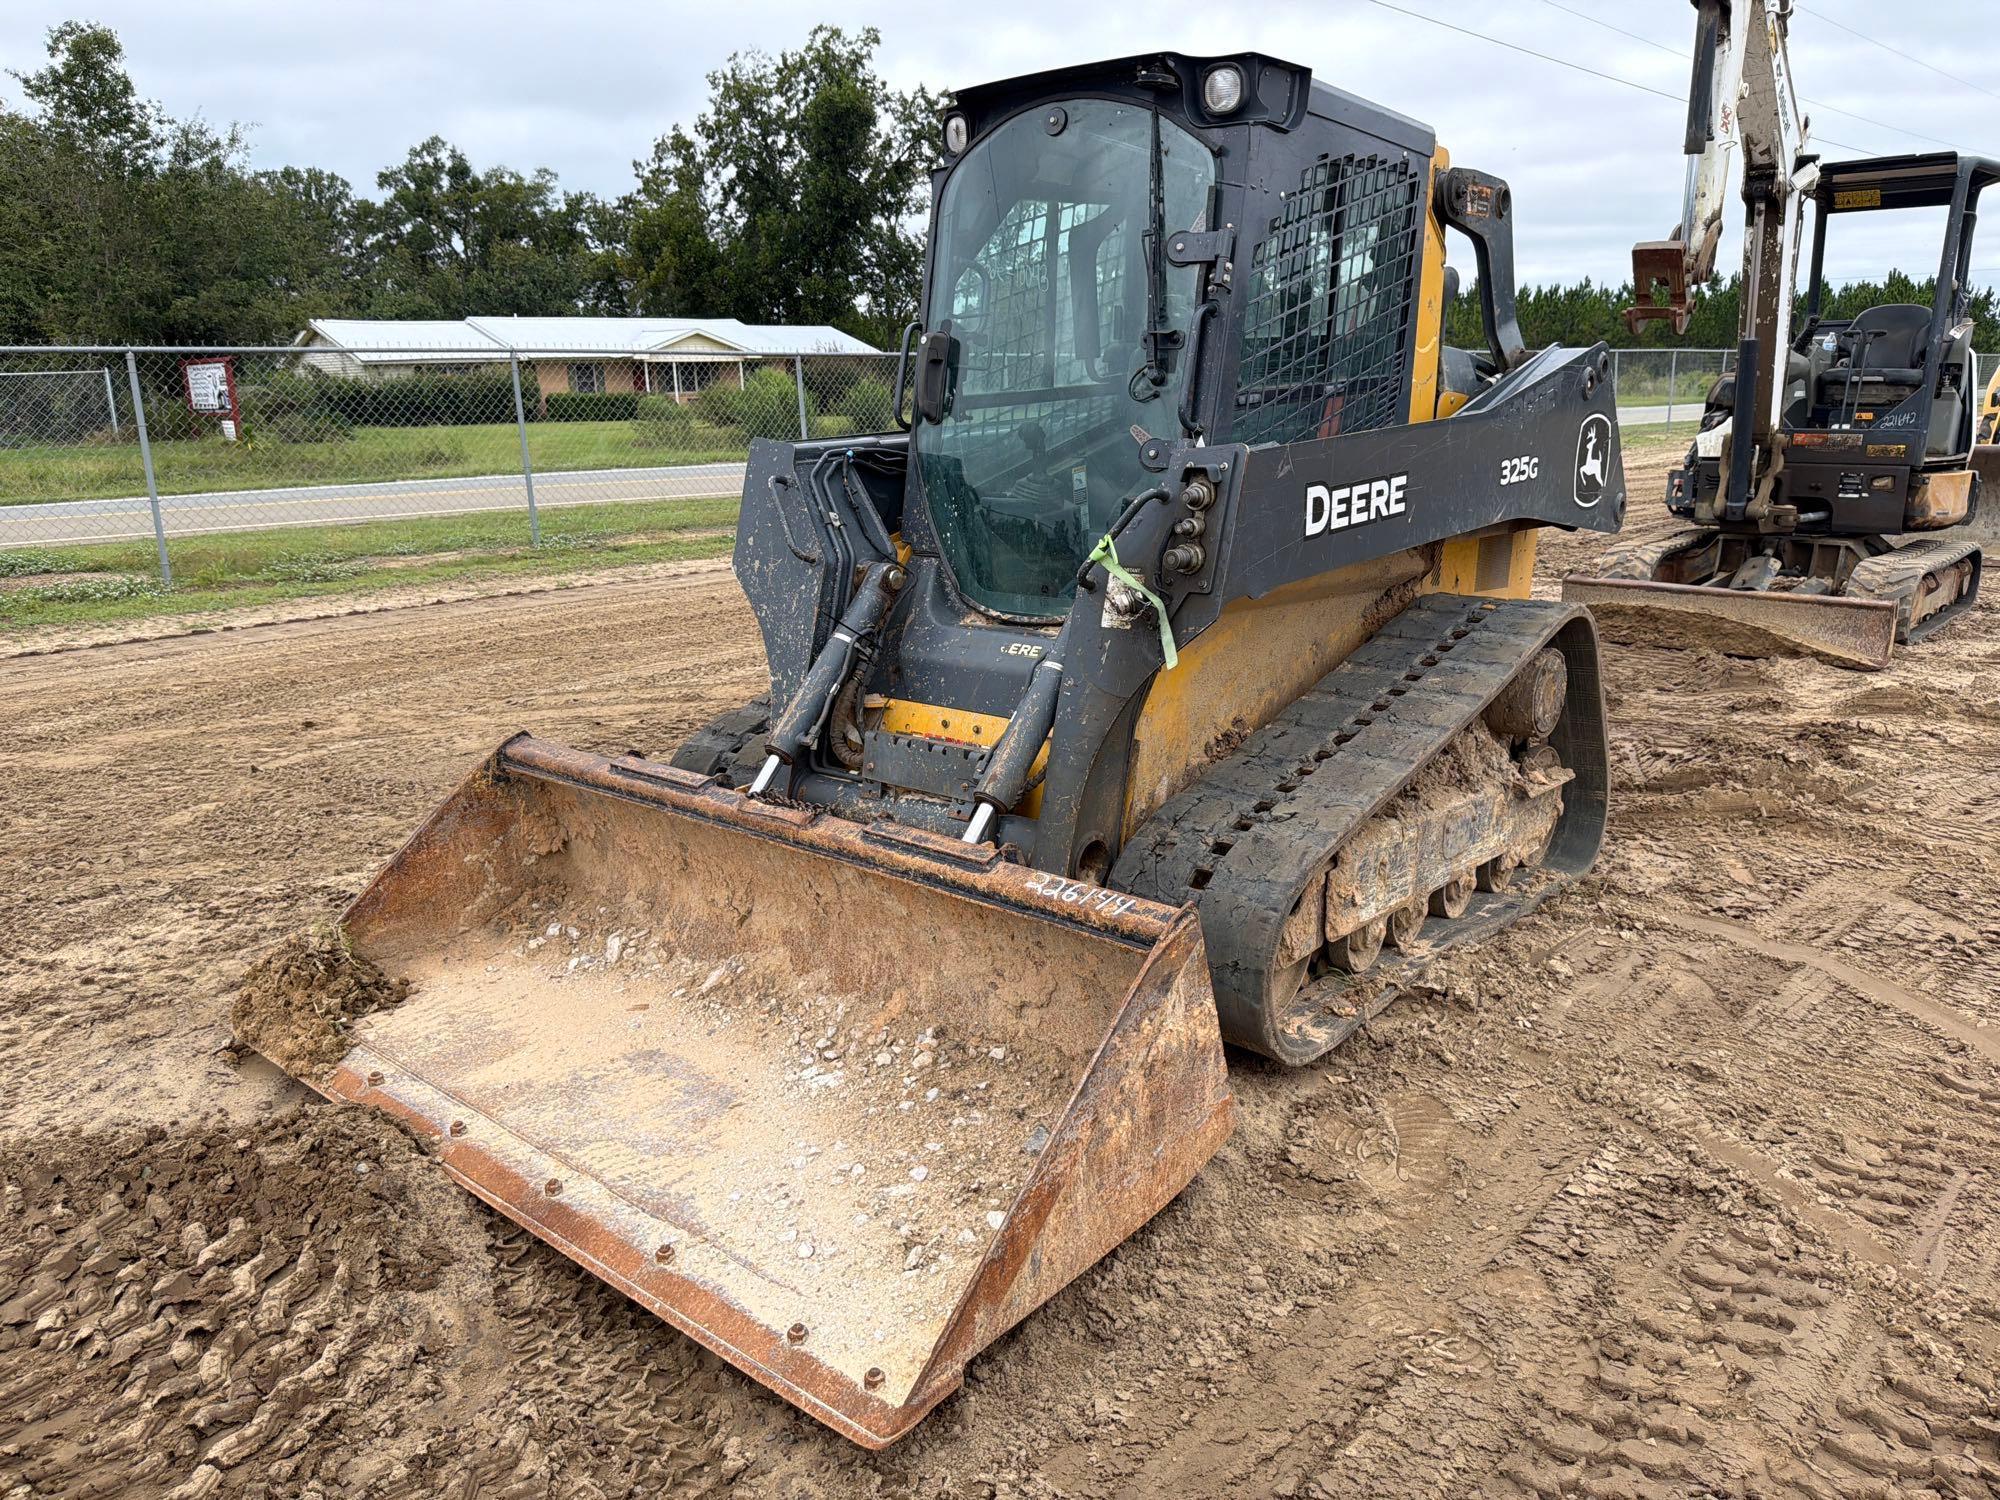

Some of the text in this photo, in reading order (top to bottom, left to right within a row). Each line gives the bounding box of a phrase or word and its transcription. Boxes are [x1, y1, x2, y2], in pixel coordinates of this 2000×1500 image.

[1499, 456, 1539, 486] 325G
[1305, 475, 1407, 537] DEERE
[1000, 642, 1043, 657] ERE
[1026, 872, 1136, 915] 226144
